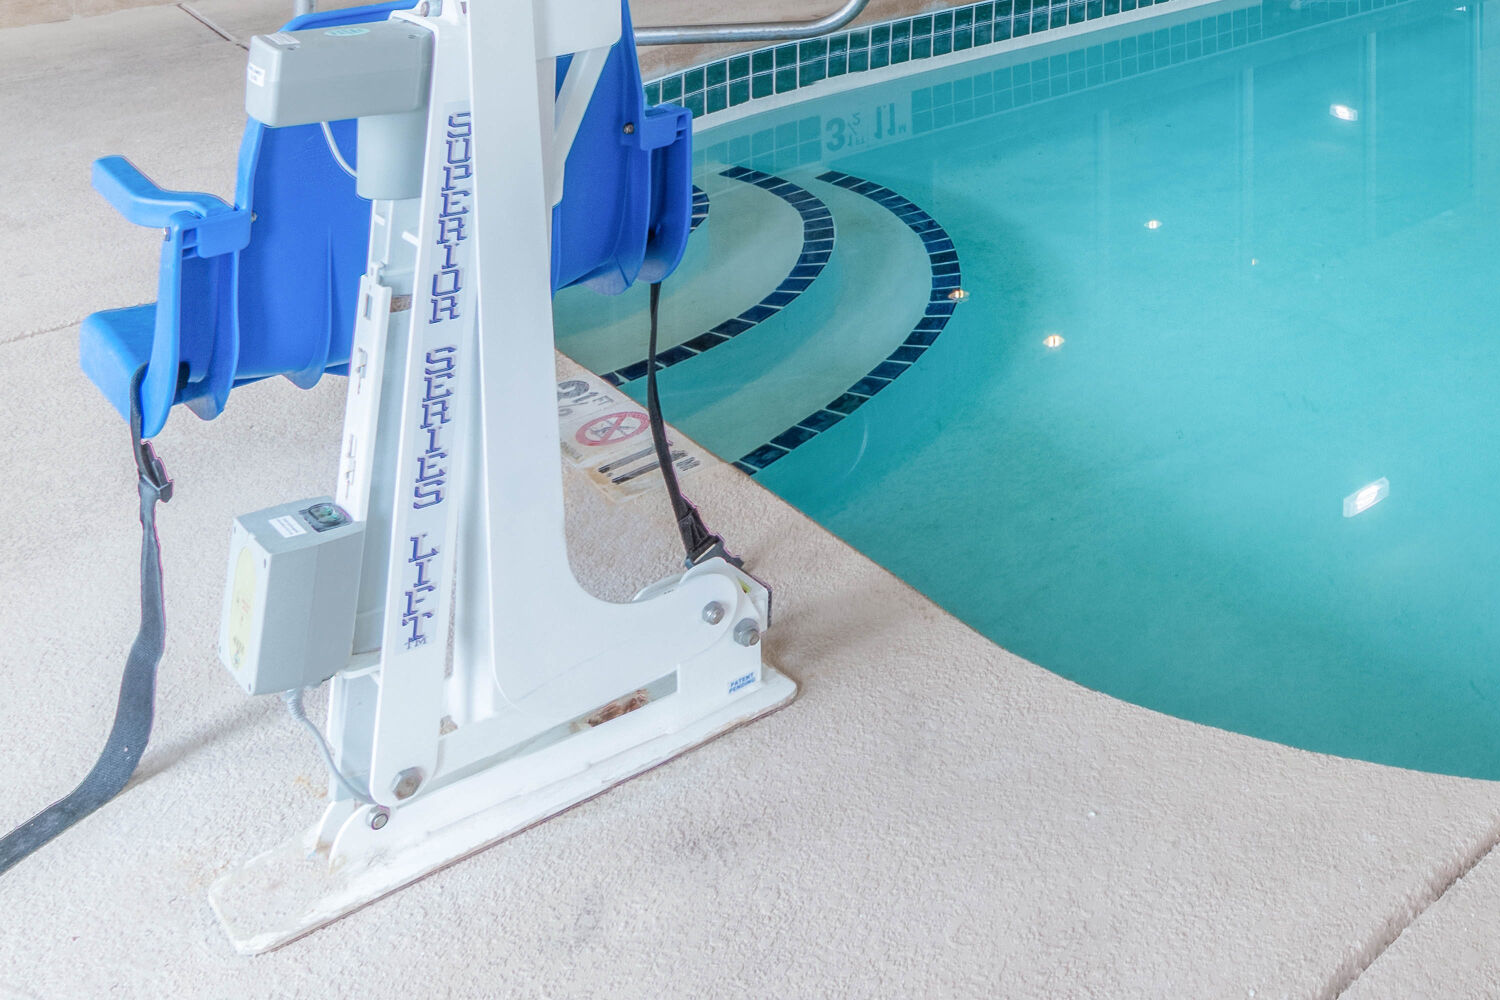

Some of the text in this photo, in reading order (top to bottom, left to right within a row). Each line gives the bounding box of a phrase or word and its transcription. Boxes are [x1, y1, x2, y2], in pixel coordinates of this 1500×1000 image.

[428, 111, 473, 325] SUPERIOR
[413, 346, 457, 510] SERIES
[402, 531, 440, 642] LIFT
